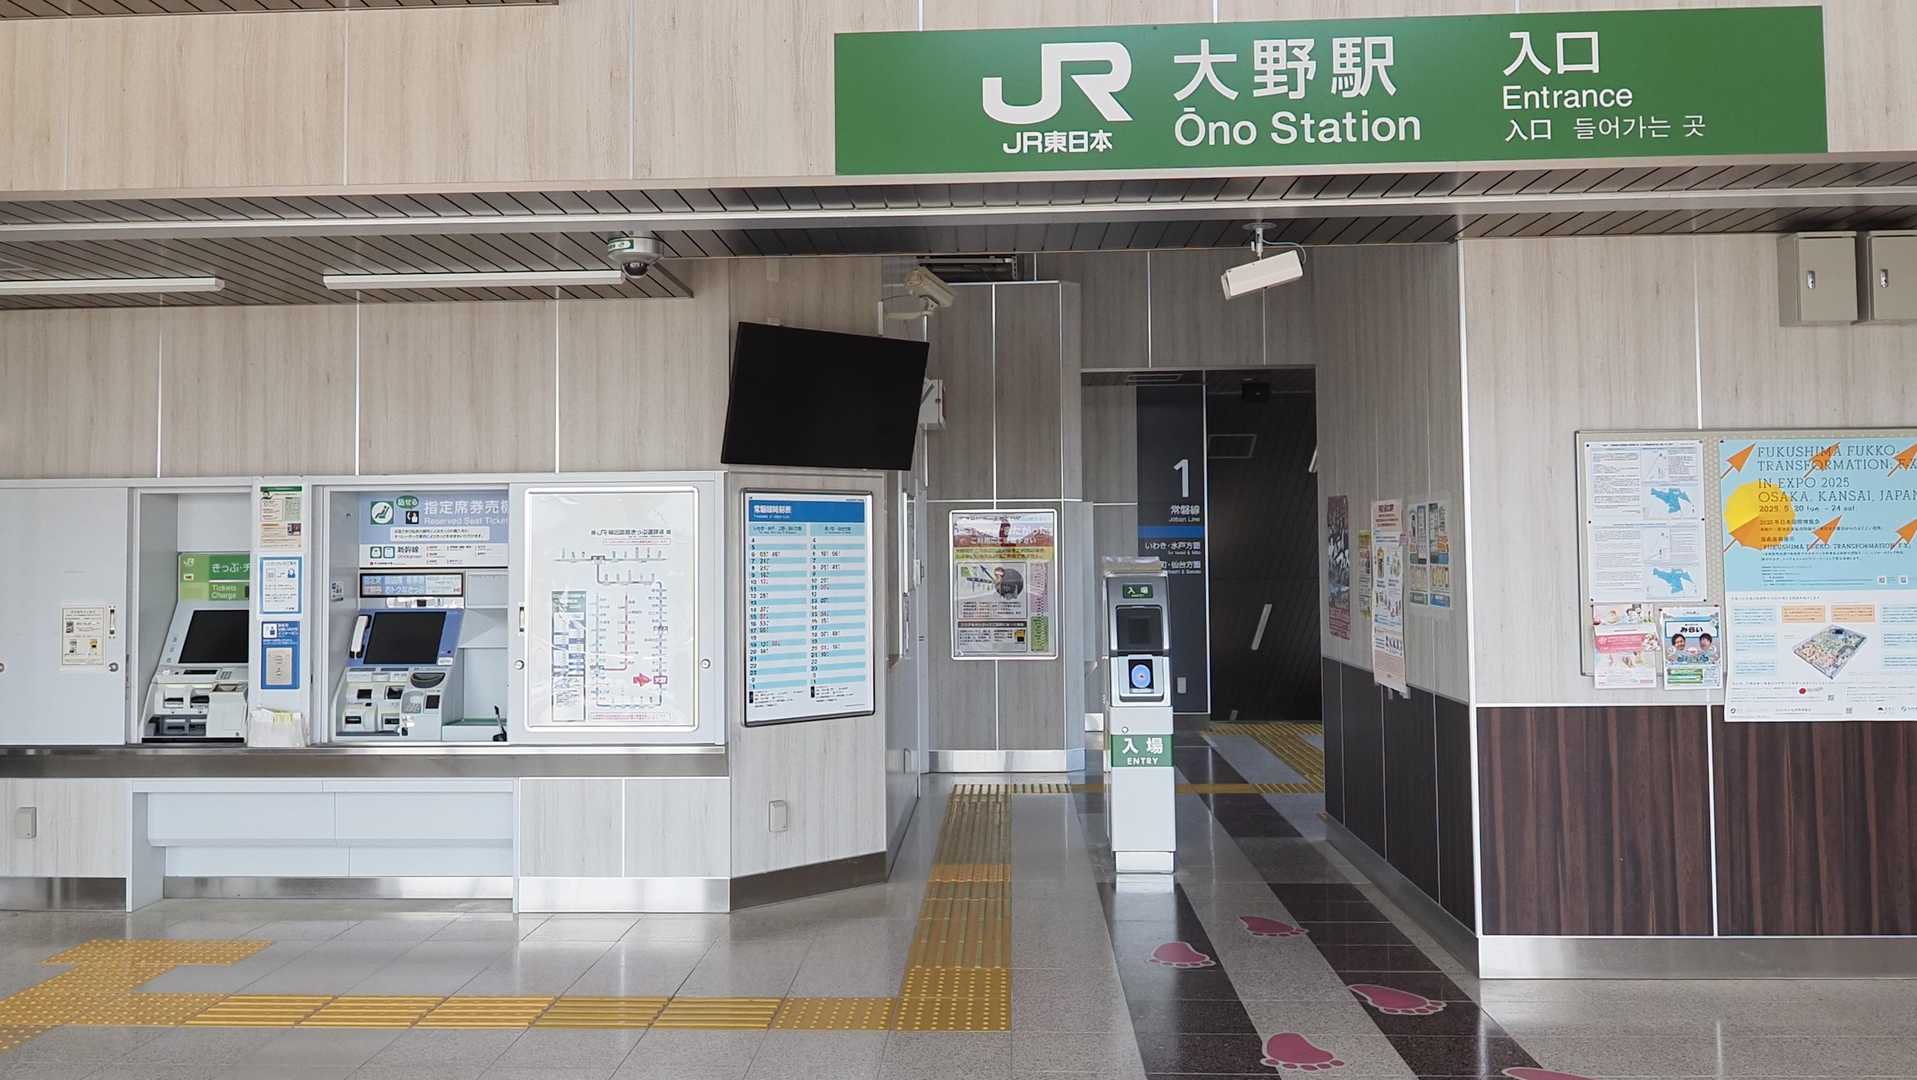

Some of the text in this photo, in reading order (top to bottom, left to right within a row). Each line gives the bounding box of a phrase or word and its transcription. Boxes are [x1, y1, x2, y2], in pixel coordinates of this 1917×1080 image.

[1503, 31, 1601, 76] 入口
[1173, 36, 1397, 102] 大野駅
[982, 41, 1133, 125] JR
[1503, 85, 1633, 111] Entrance
[1174, 107, 1423, 147] Ōno Station
[1505, 119, 1553, 142] 入口
[1574, 114, 1707, 141] 들어가는 곳
[1002, 130, 1113, 155] JR東日本
[1847, 445, 1895, 456] FUKKO
[1173, 459, 1189, 498] 1
[1758, 477, 1850, 488] IN EXPO 2025
[1122, 737, 1164, 754] 入場
[1127, 758, 1159, 766] ENTRY
